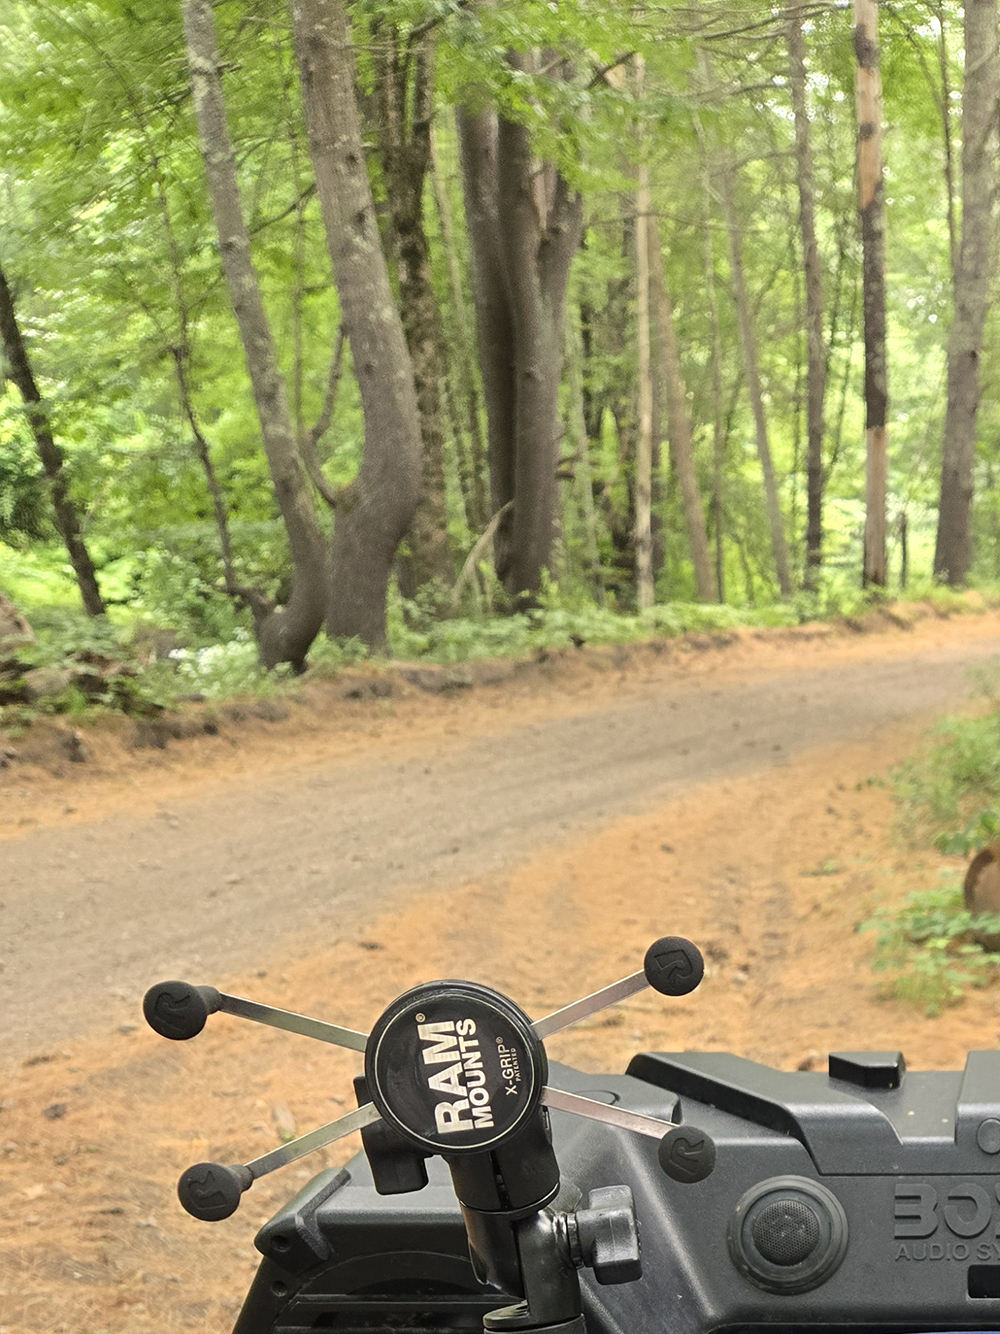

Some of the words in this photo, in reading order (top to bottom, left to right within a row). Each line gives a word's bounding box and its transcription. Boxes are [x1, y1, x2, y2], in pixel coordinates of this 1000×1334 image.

[456, 1018, 494, 1128] MOUNTS
[510, 1047, 522, 1082] PATENTED
[895, 1242, 970, 1261] AUDIO
